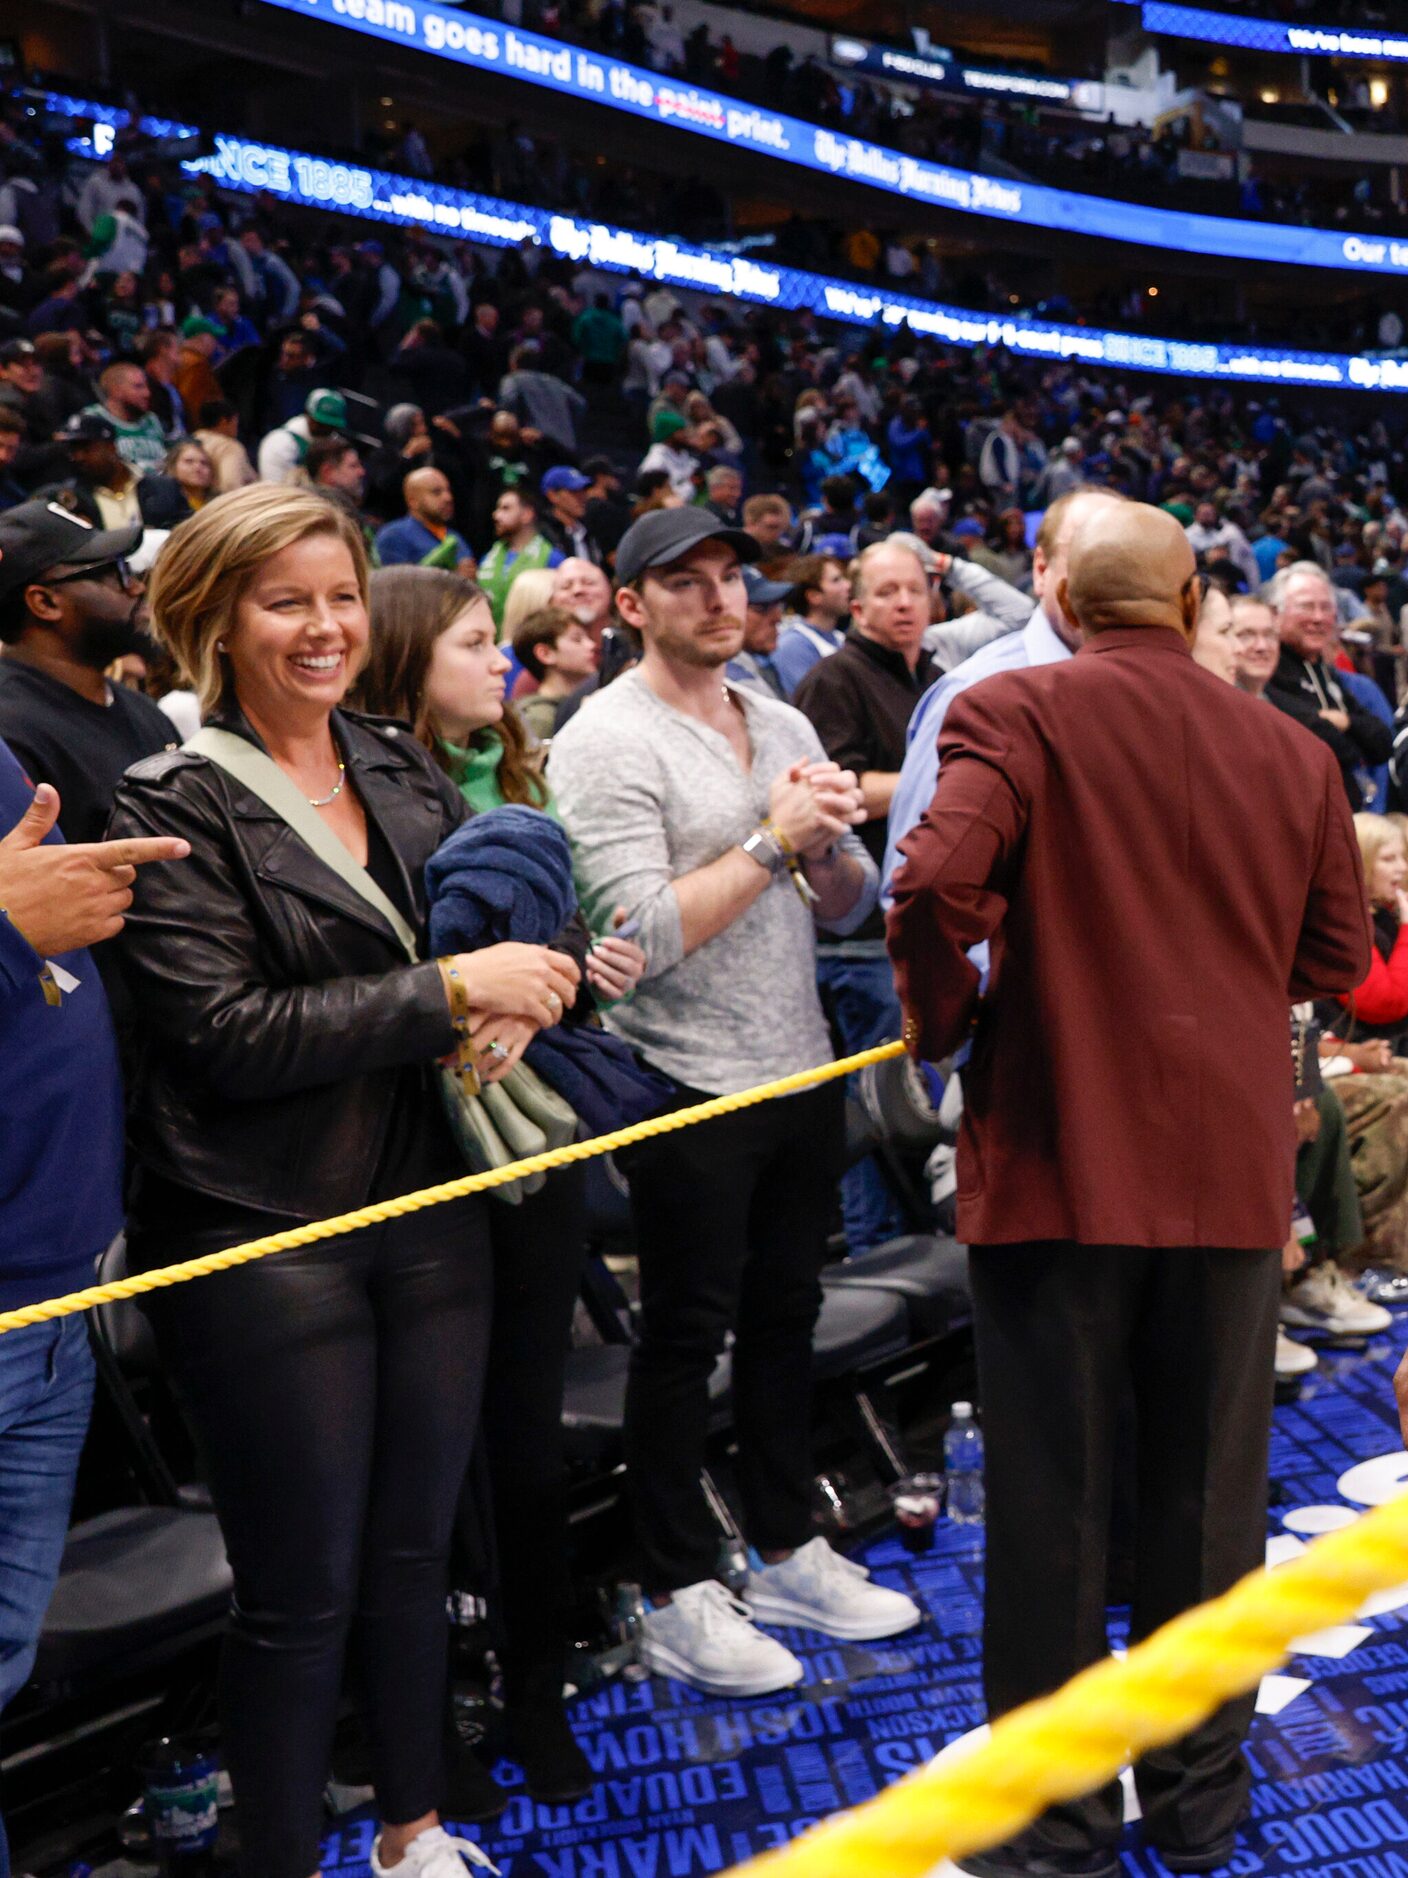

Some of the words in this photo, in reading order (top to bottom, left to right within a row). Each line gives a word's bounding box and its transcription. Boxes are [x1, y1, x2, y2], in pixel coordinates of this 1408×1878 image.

[423, 14, 499, 60] goes
[505, 32, 571, 82] hard
[577, 54, 605, 92] in
[609, 67, 654, 107] the
[726, 109, 790, 150] print.
[293, 156, 373, 210] 1885
[1342, 236, 1387, 263] Our
[713, 1696, 843, 1753] JOSH
[865, 1702, 989, 1741] ACKSON
